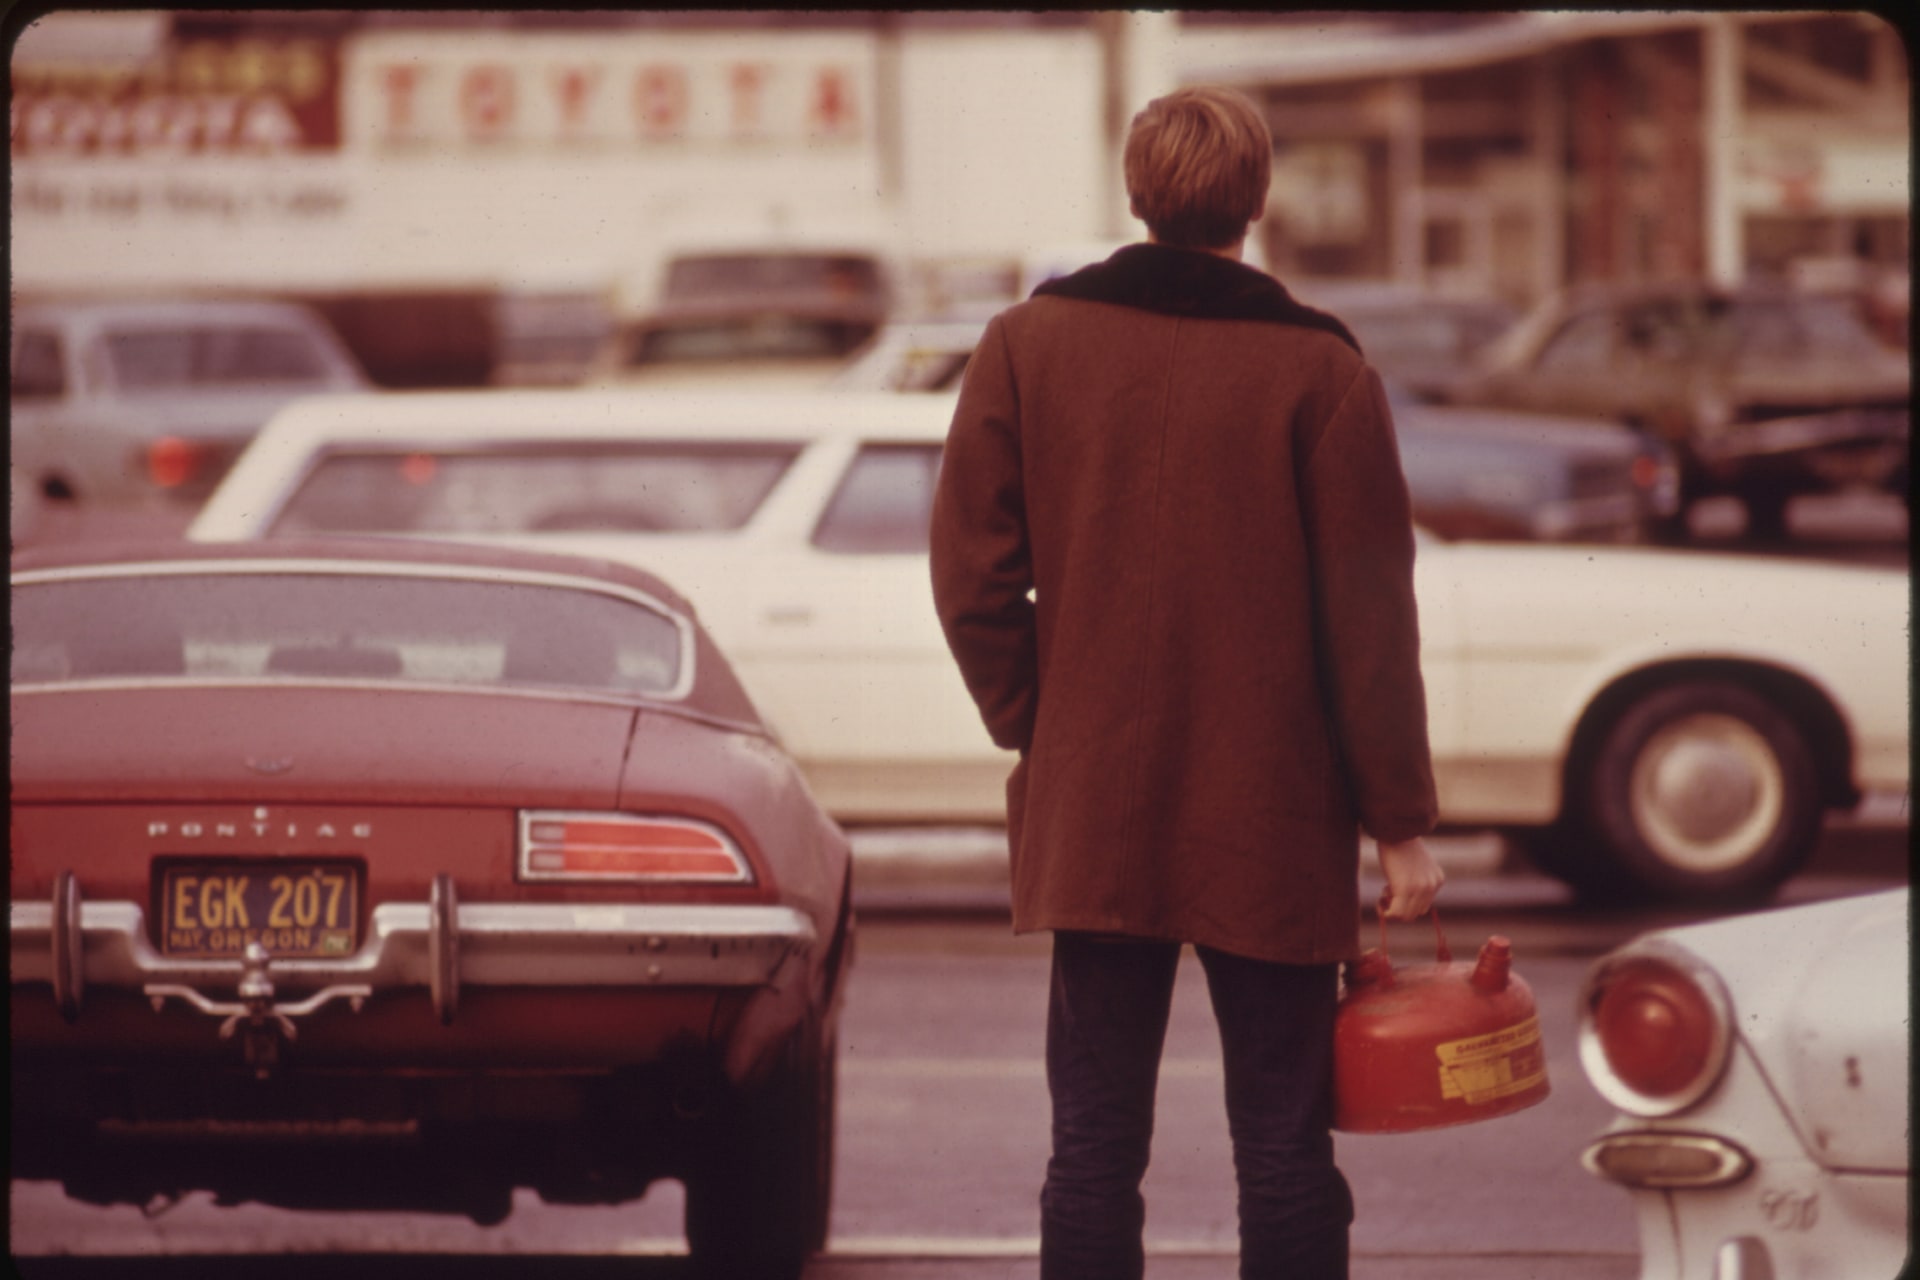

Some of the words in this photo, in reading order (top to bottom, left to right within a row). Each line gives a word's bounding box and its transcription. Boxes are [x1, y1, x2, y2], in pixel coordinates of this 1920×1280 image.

[377, 62, 861, 147] TOYOTA
[148, 822, 371, 838] PONTIAC
[174, 876, 250, 929] EGK
[268, 875, 345, 929] 207
